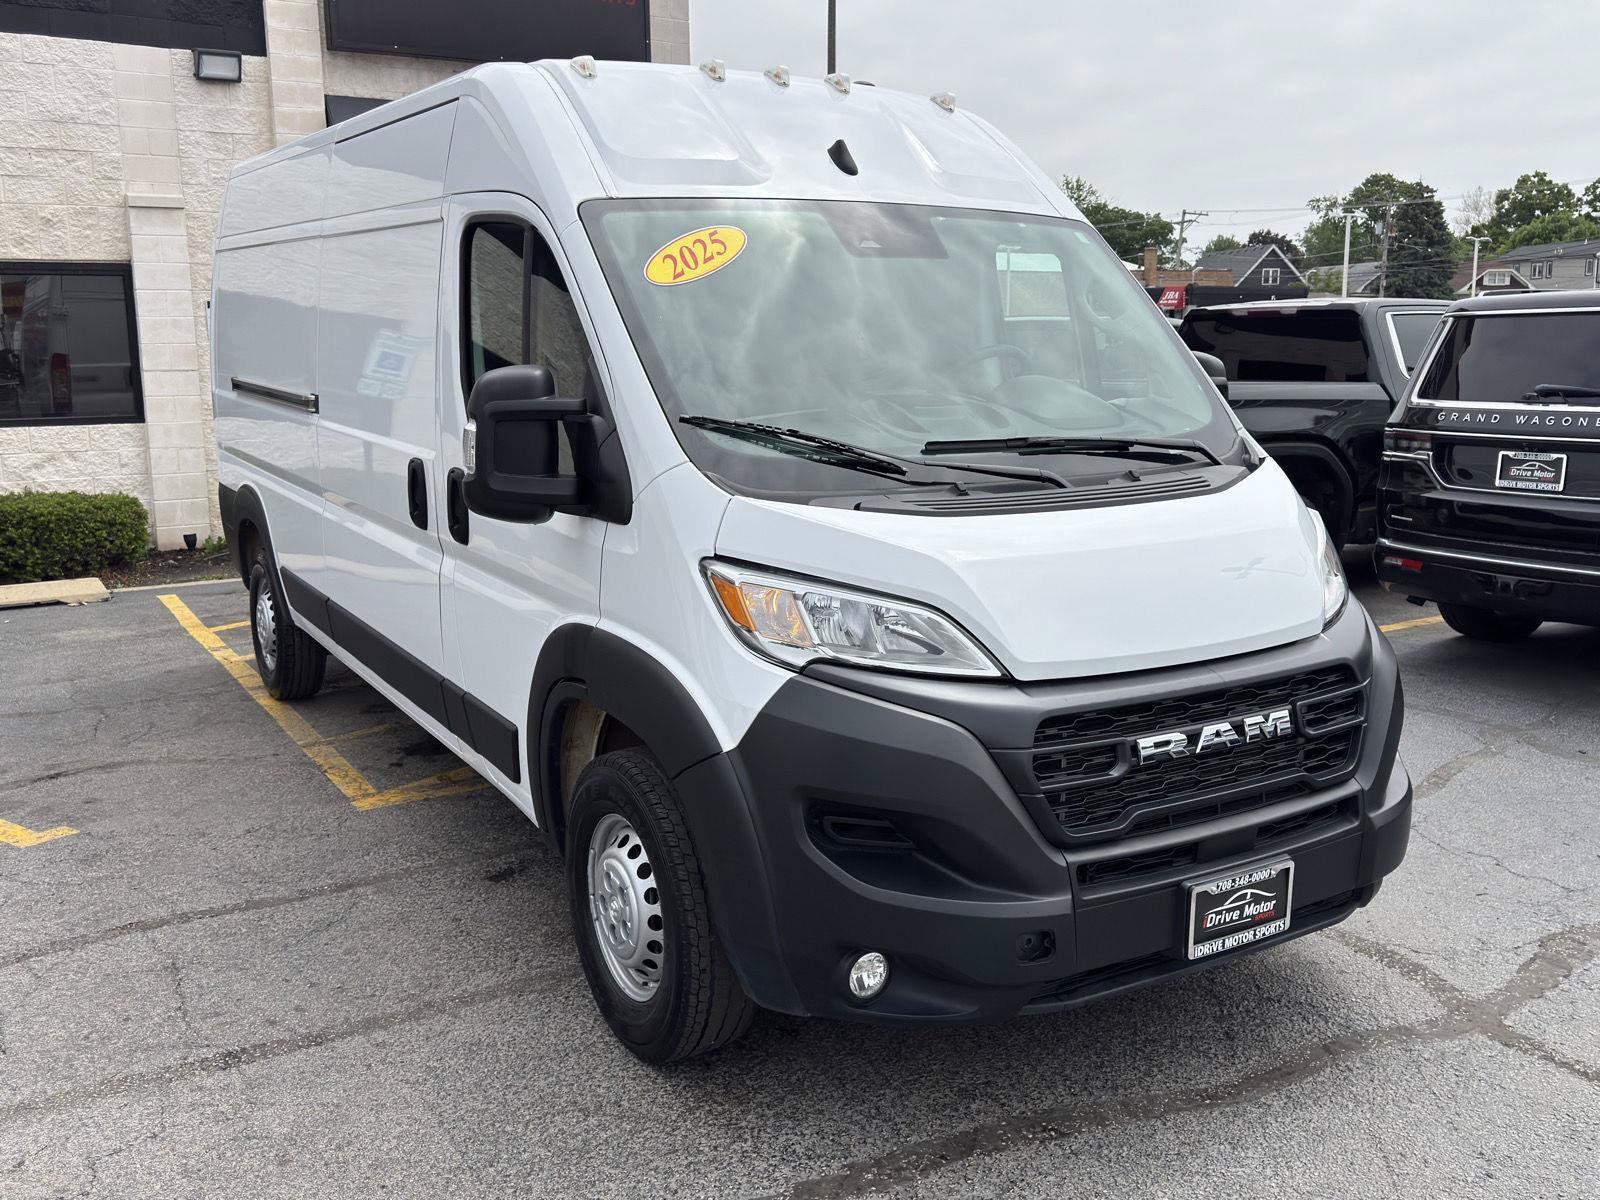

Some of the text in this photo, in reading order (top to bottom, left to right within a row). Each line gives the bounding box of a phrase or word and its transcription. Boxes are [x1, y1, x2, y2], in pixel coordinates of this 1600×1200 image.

[662, 230, 727, 280] 2025
[1437, 412, 1500, 423] GRAND
[1508, 468, 1555, 478] Drive Motor
[1516, 482, 1537, 490] MOTOR
[1136, 709, 1293, 765] RAM
[1217, 869, 1271, 892] 708-348-0000
[1202, 900, 1277, 929] iDrive Motor
[1225, 933, 1254, 948] MOTOR
[1256, 921, 1284, 938] SPORTS
